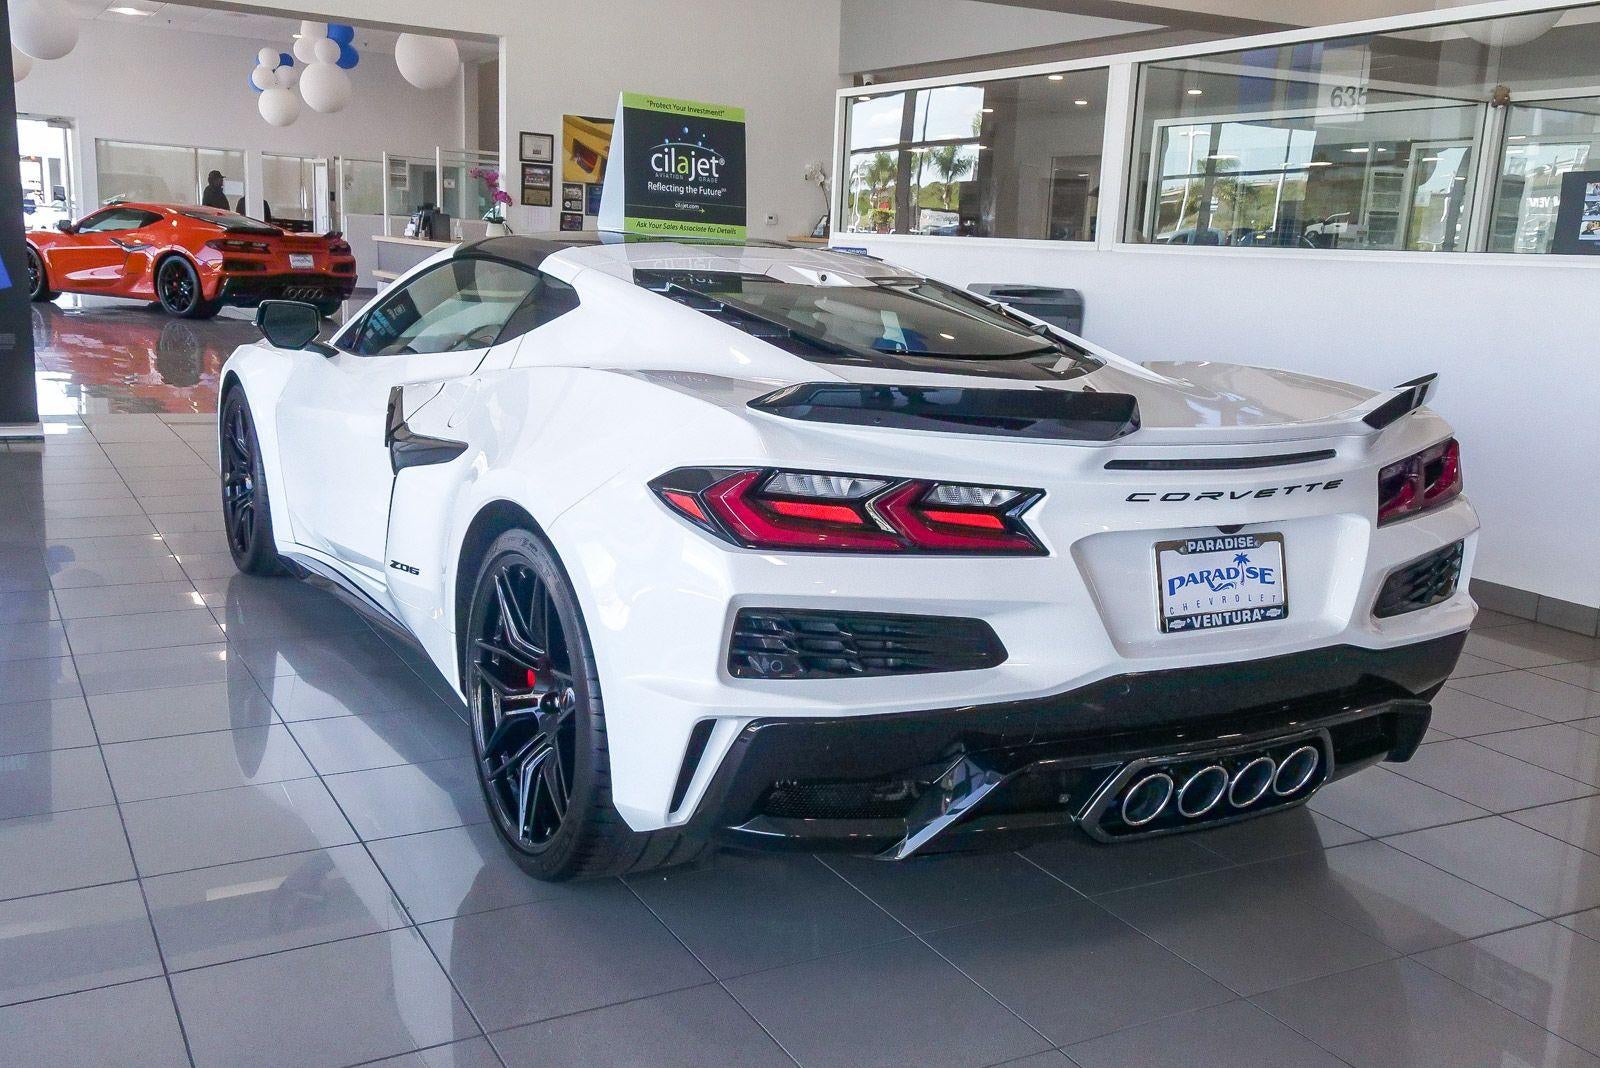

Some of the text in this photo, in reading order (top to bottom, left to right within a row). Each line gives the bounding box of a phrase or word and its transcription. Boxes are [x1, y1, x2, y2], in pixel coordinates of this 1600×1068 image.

[673, 103, 686, 112] Your
[655, 172, 718, 184] AVIATION GRADE
[647, 181, 684, 195] Reflecting
[685, 186, 697, 195] the
[648, 221, 662, 230] Your
[663, 222, 679, 231] Sales
[679, 224, 707, 233] Associate
[707, 225, 716, 234] for
[716, 227, 737, 235] Details
[1125, 479, 1344, 502] CORVETTE
[1187, 536, 1255, 553] PARADISE
[389, 559, 420, 576] Z06
[1168, 557, 1276, 597] PARADISE
[1169, 594, 1277, 615] CHEVROLET
[1191, 608, 1263, 628] VENTURA
